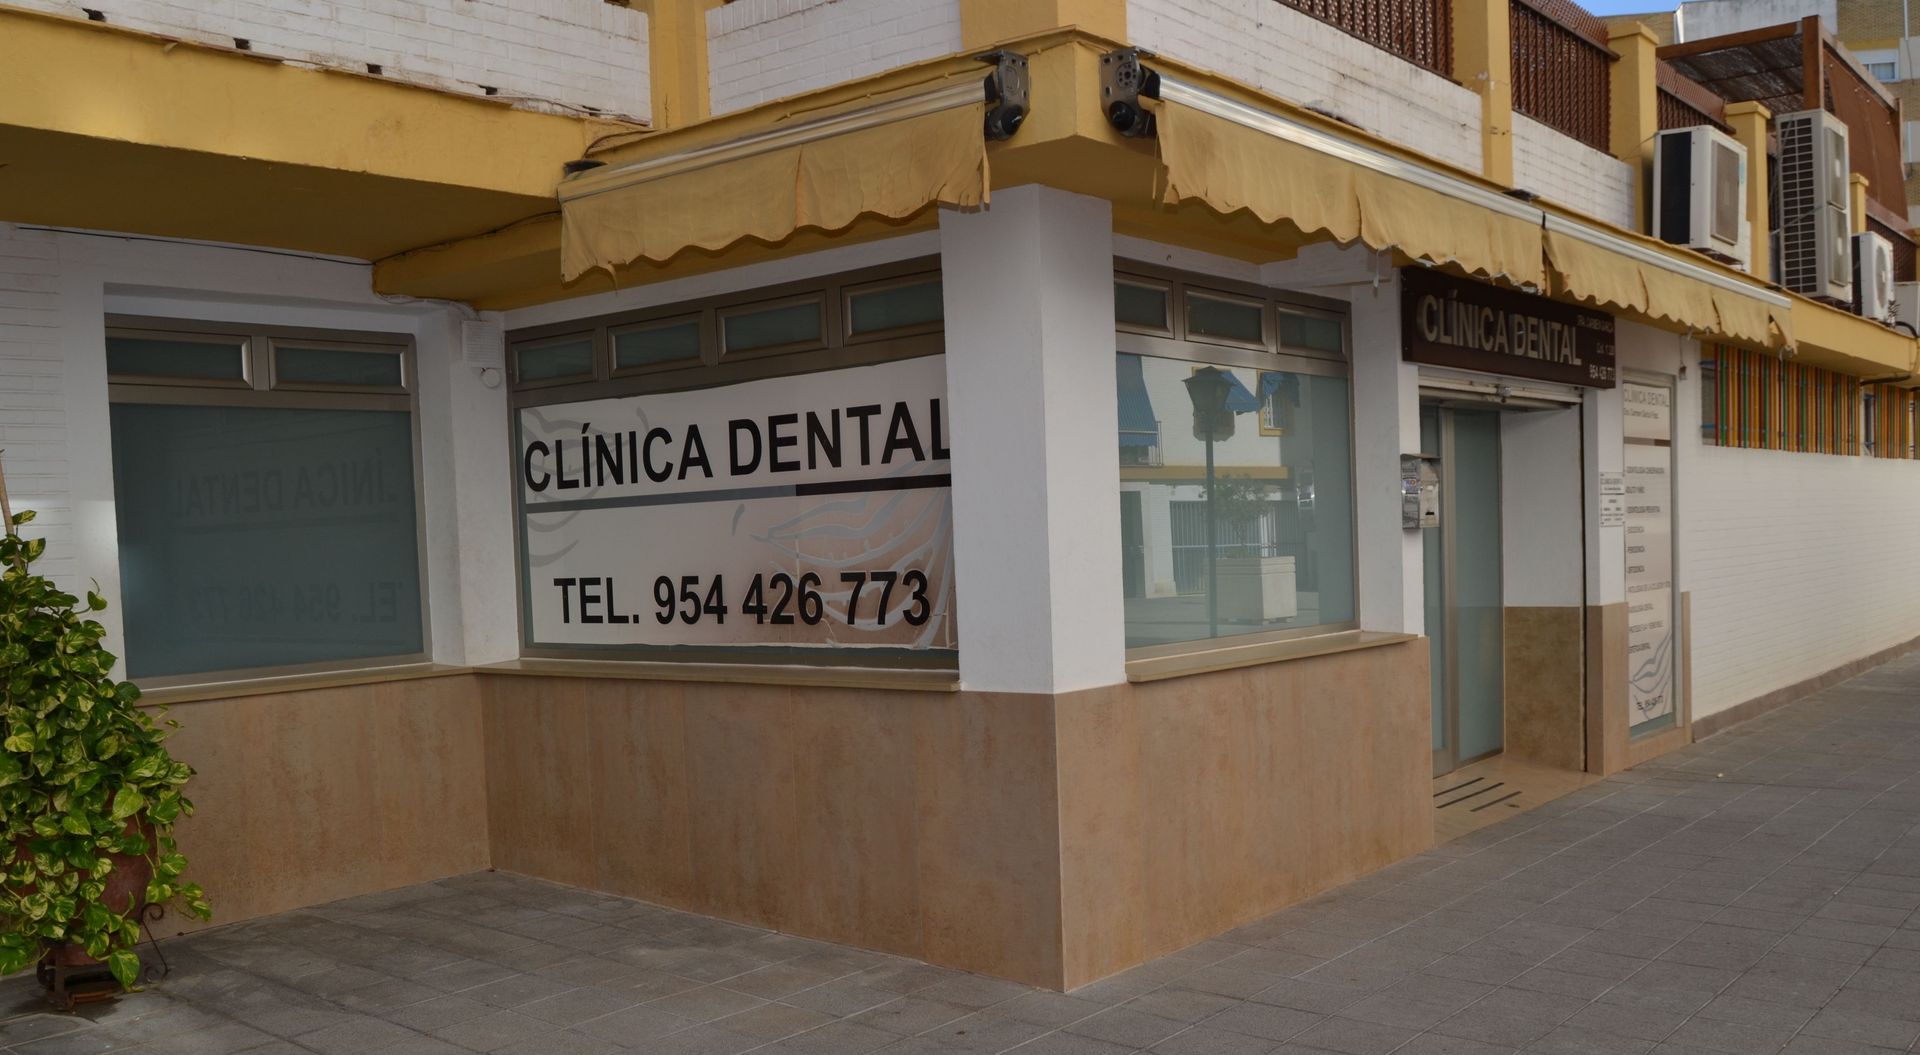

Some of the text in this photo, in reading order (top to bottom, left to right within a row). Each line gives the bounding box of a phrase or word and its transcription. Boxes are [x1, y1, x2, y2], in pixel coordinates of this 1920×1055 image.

[1418, 289, 1582, 366] CLÍNICA DENTAL
[524, 398, 950, 493] CLÍNICA DENTAL
[553, 569, 931, 626] TEL. 954 426 773
